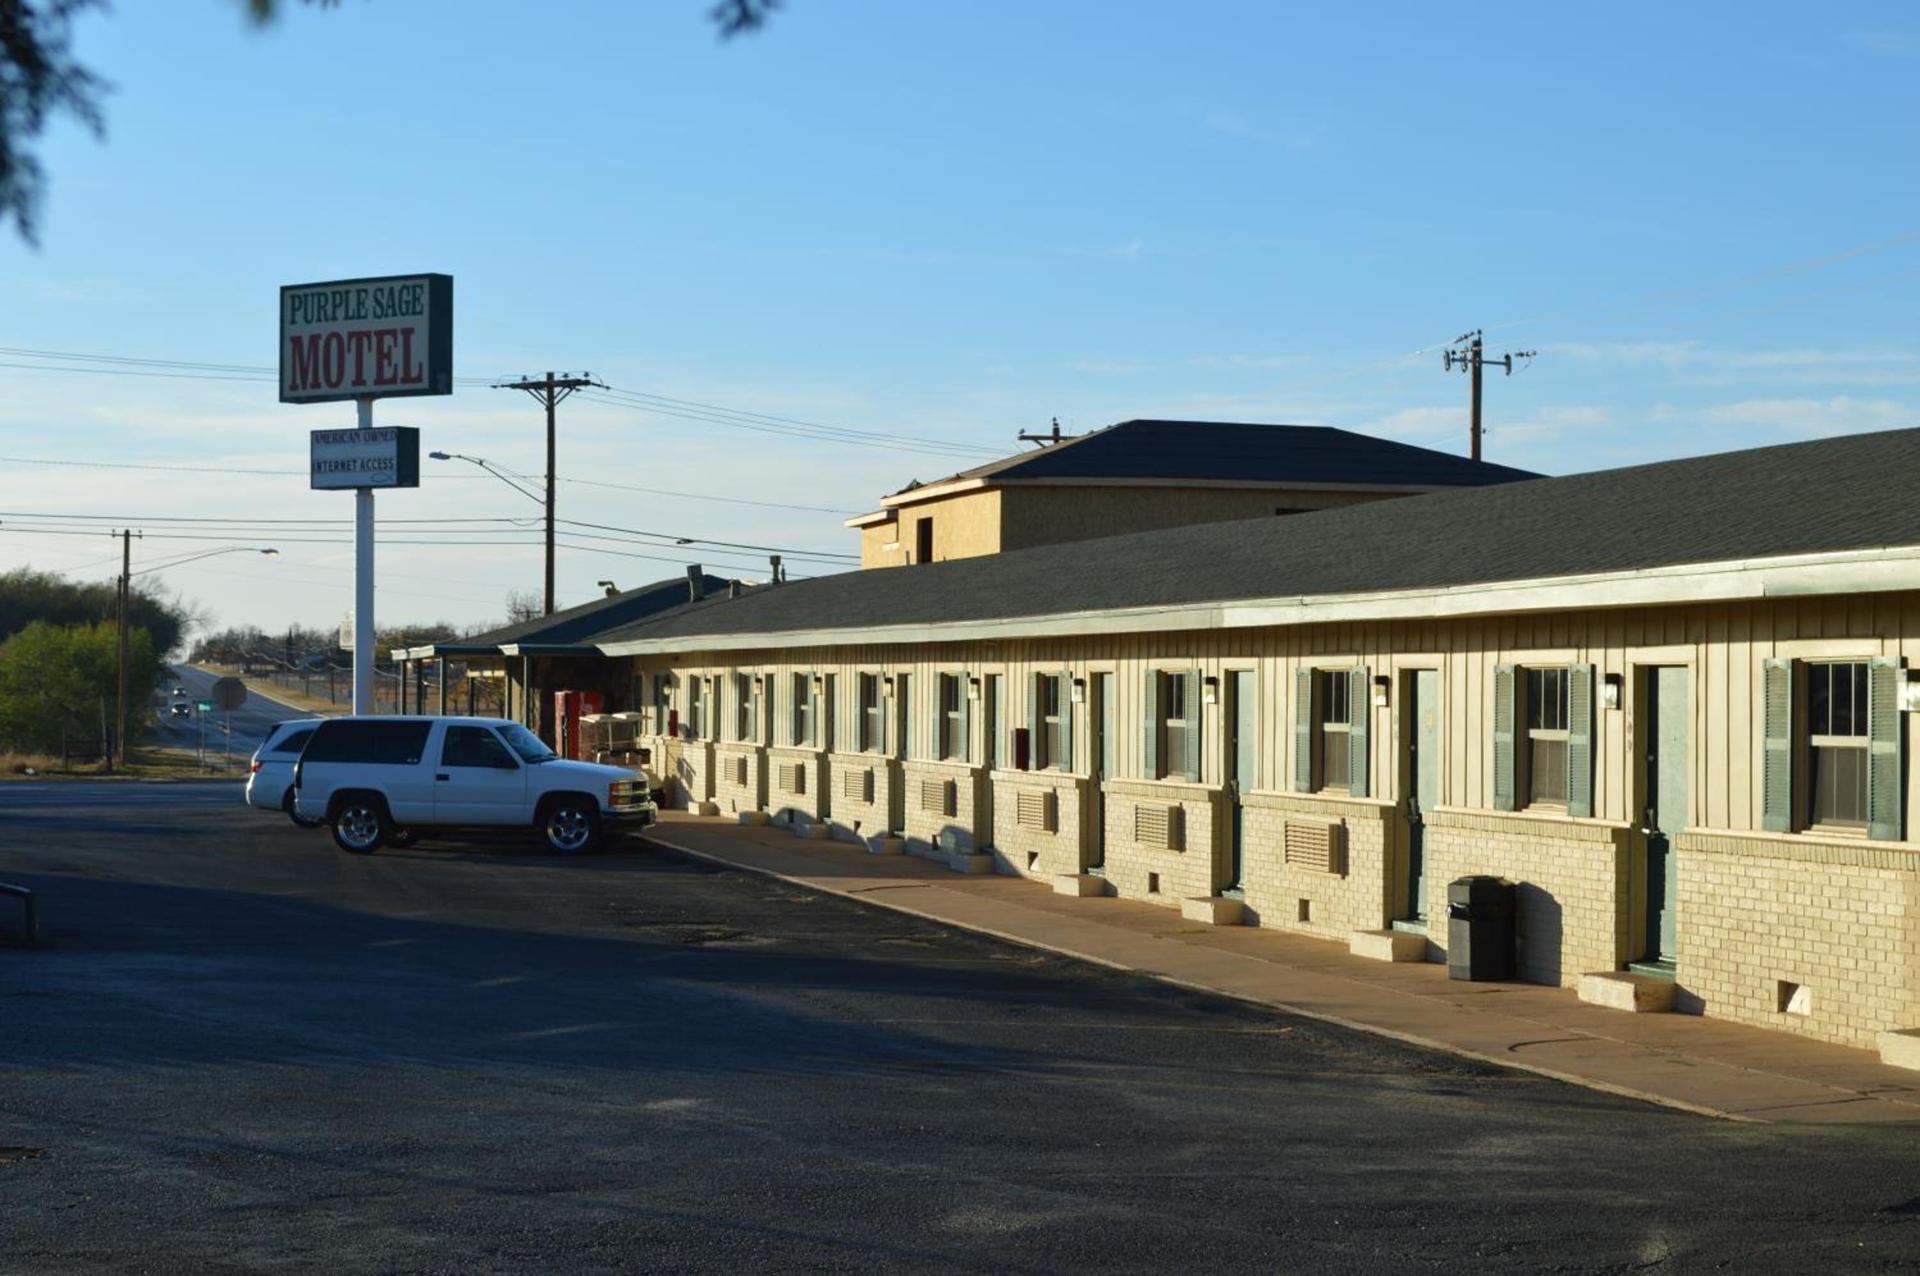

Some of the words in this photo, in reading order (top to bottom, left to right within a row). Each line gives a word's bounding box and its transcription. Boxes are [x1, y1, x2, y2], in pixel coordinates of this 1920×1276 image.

[289, 289, 368, 325] PURPLE
[372, 284, 424, 319] SAGE
[289, 327, 423, 391] MOTEL
[360, 456, 394, 472] ACCESS
